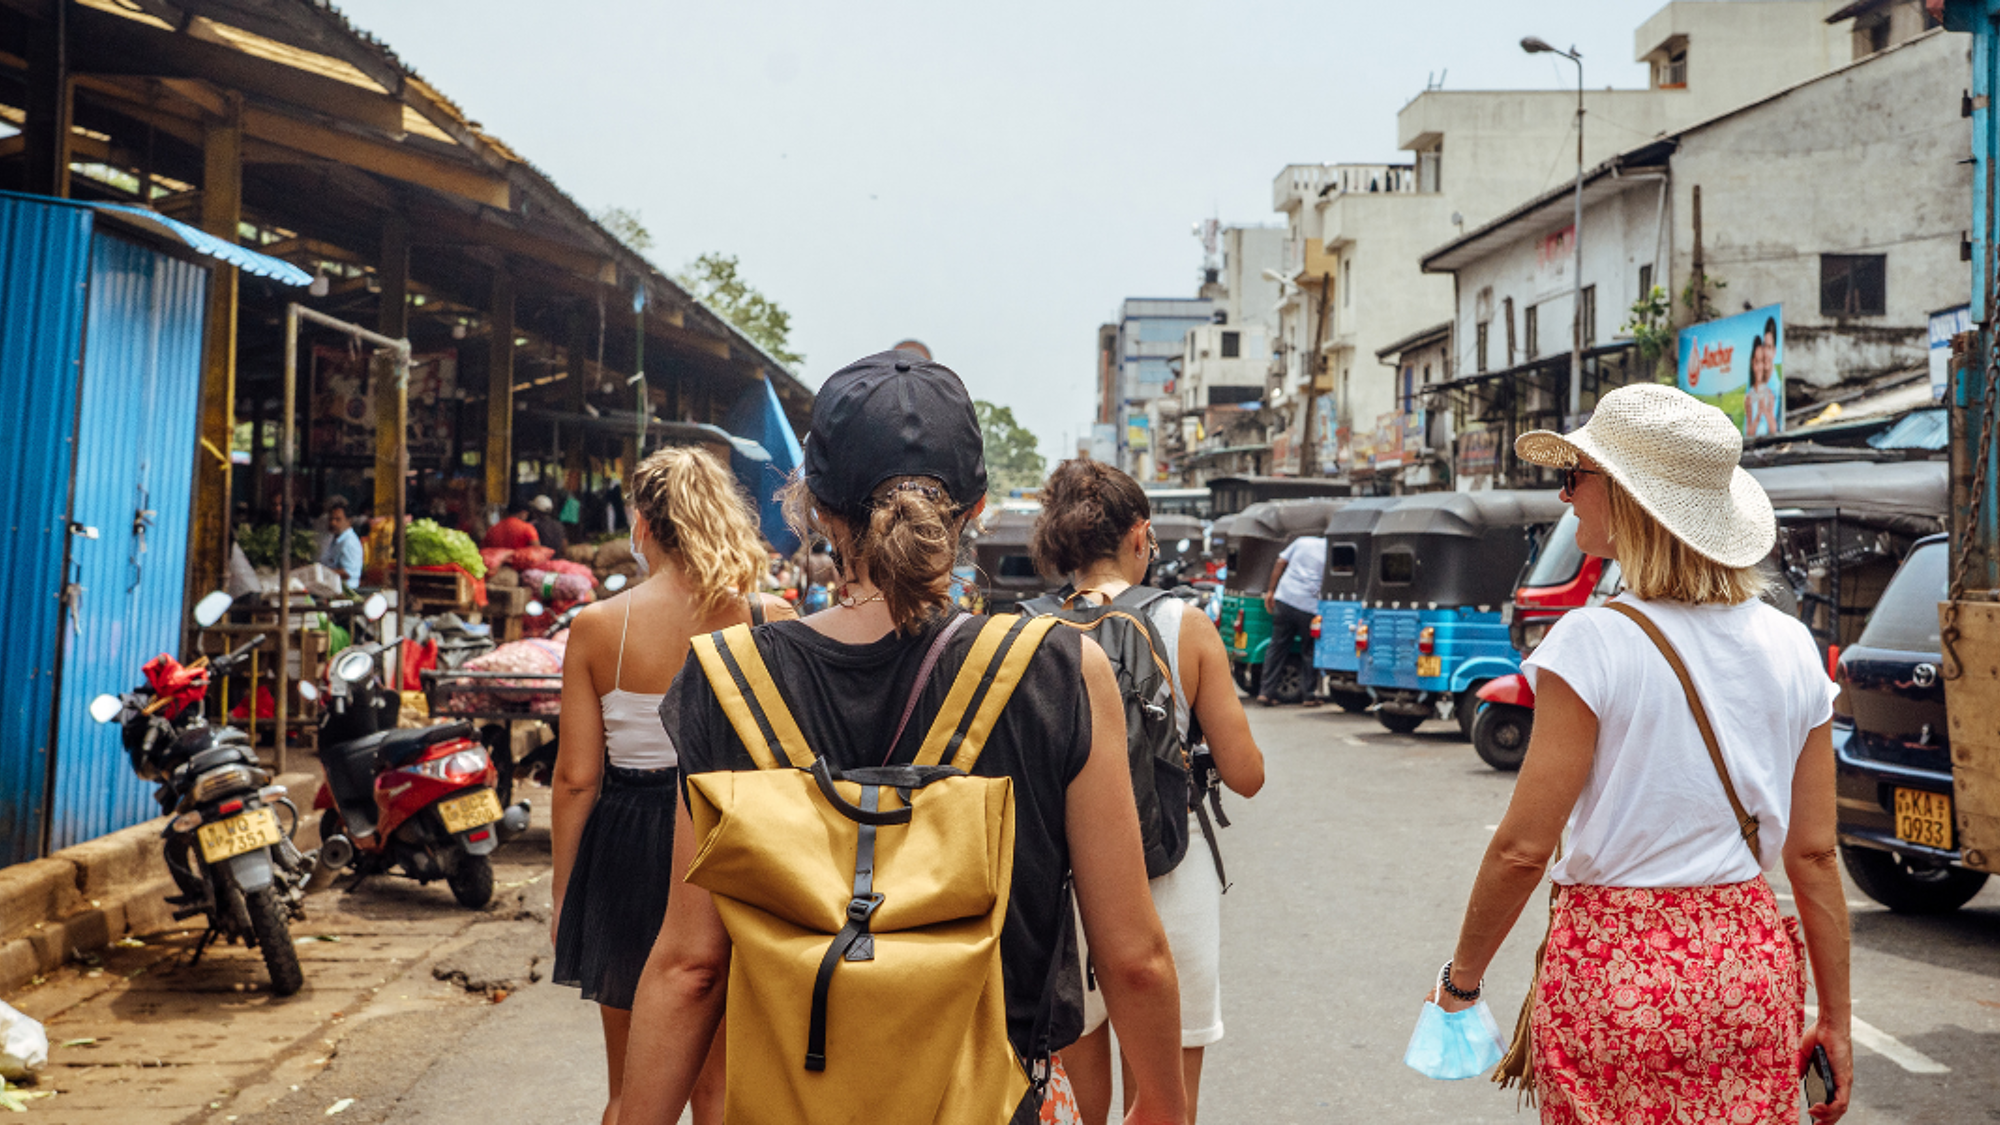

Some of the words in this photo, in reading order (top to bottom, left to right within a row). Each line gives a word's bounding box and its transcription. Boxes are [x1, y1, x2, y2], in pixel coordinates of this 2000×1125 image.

[1701, 342, 1734, 369] Anchor
[1911, 791, 1933, 817] KA
[226, 829, 267, 853] 7351
[1903, 815, 1944, 845] 0933
